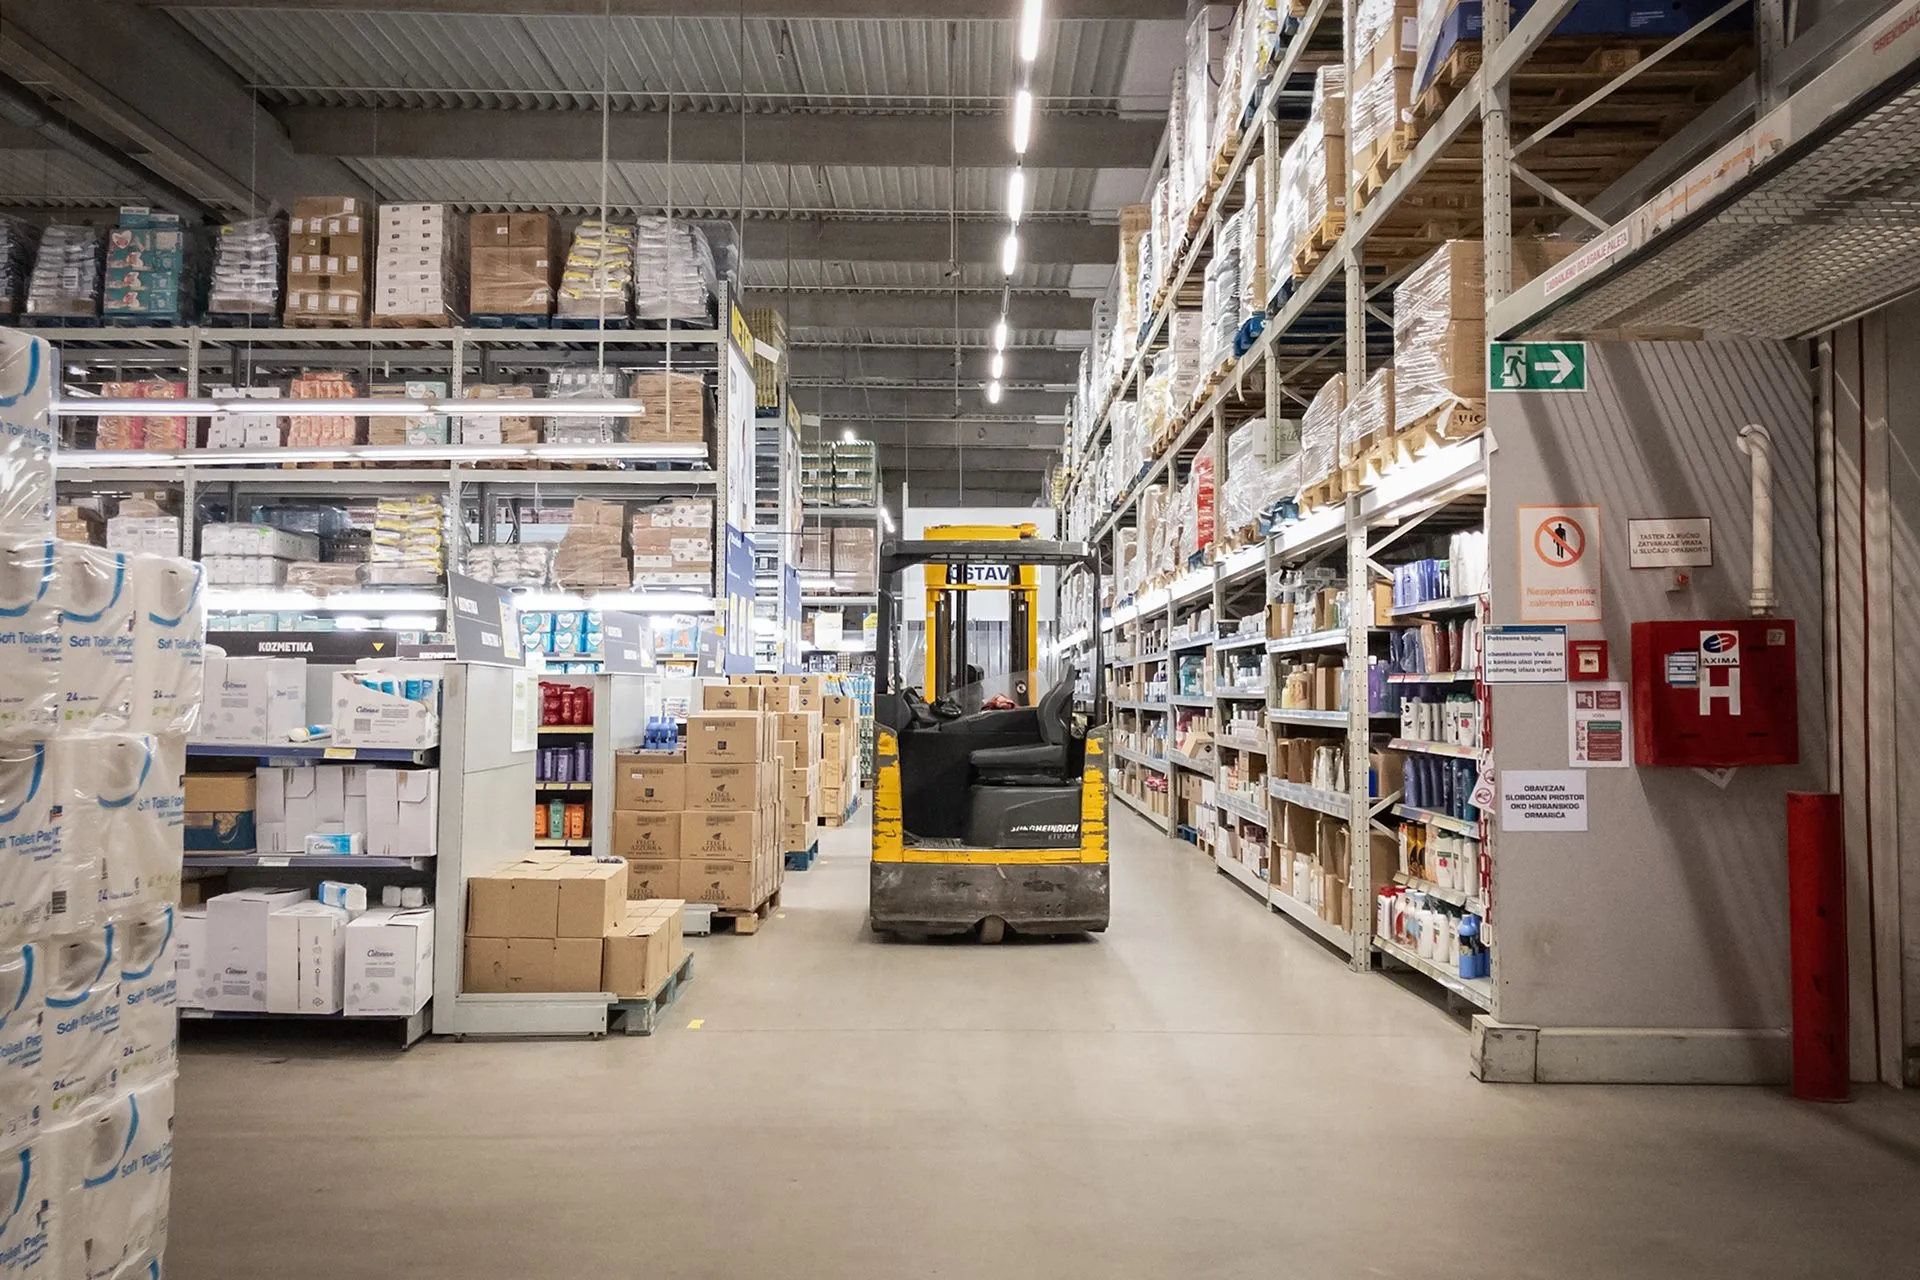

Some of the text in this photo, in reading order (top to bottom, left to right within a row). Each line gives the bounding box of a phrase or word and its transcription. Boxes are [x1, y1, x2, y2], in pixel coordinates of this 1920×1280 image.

[1638, 540, 1680, 548] ZATVARANJE
[69, 635, 90, 648] Soft
[258, 641, 314, 652] KOZMETIKA
[1700, 668, 1741, 716] H
[0, 1041, 23, 1057] oilet
[53, 1080, 66, 1091] 24
